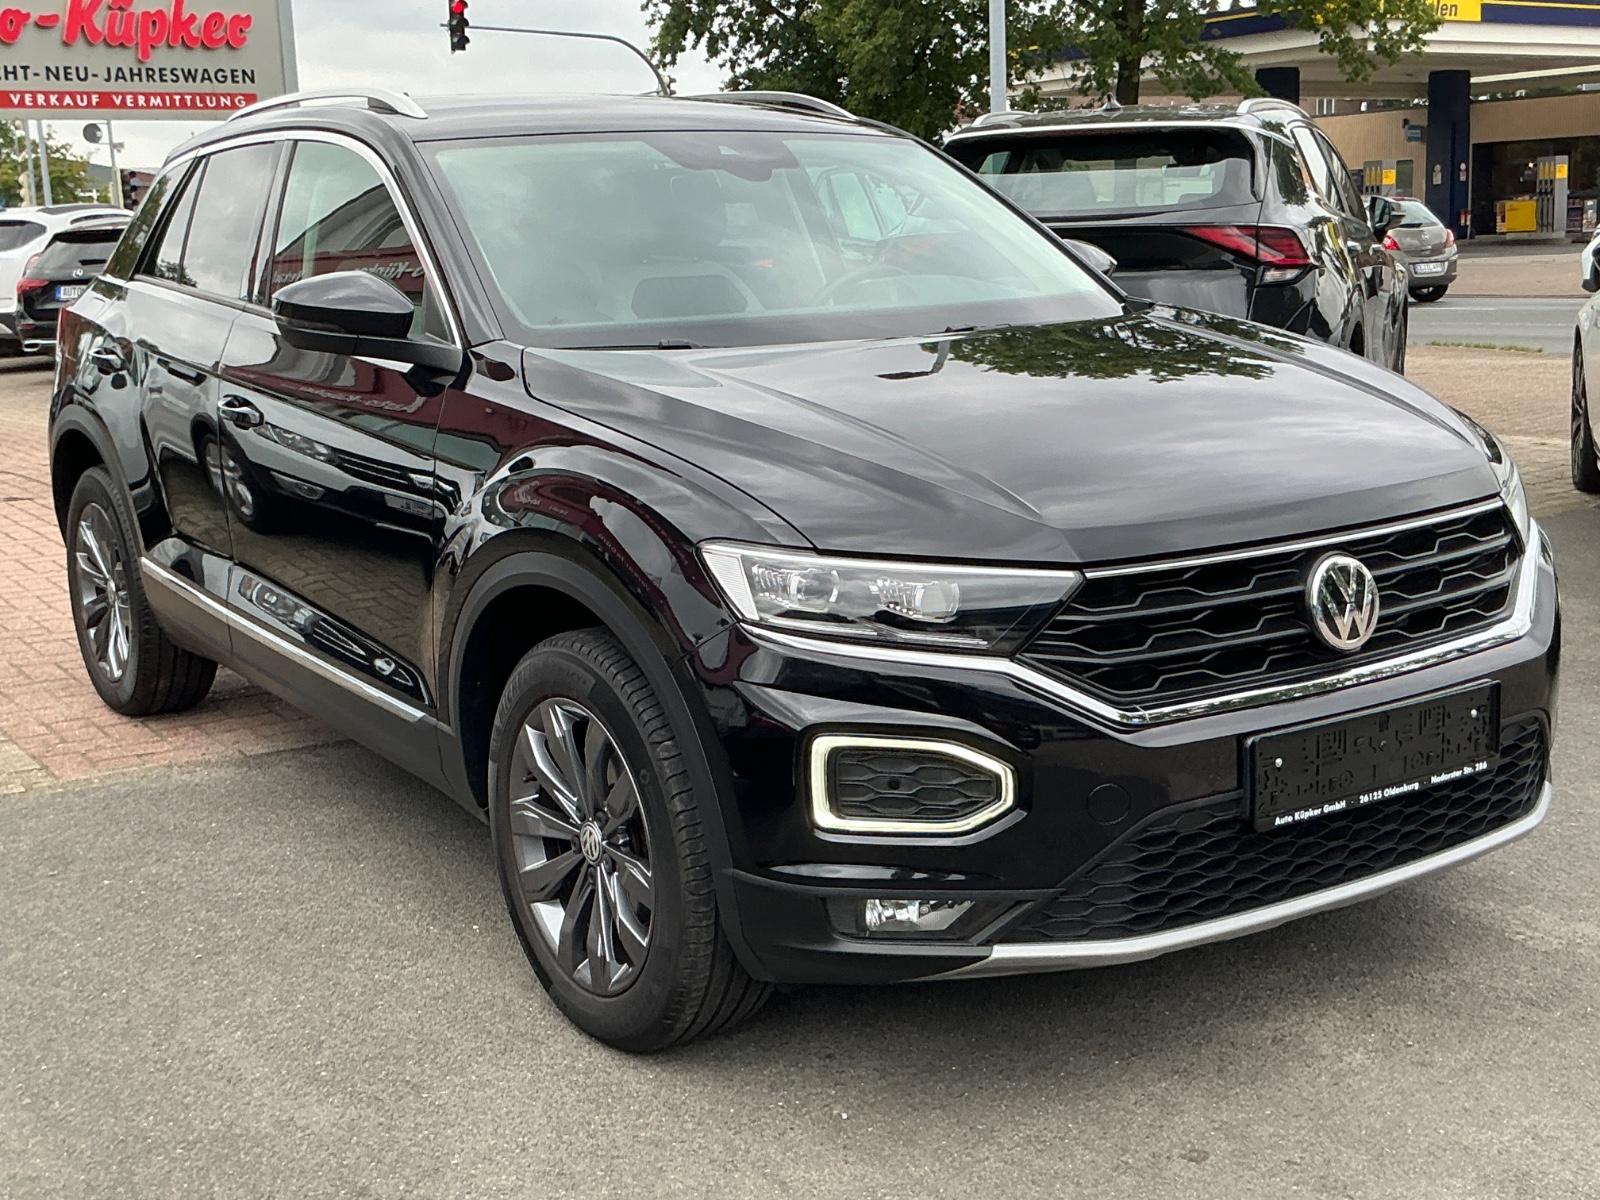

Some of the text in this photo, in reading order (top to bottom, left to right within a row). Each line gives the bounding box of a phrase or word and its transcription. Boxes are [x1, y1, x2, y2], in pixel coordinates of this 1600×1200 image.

[0, 65, 255, 84] HT-NEU-JAHRESWAGEN
[9, 93, 247, 108] VERKAUF VERMITTLUNG
[63, 287, 86, 297] AUTO
[1275, 816, 1293, 826] Auto
[1294, 808, 1322, 820] Küpker
[1323, 800, 1346, 813] GmbH
[1383, 782, 1420, 797] Oldenburg
